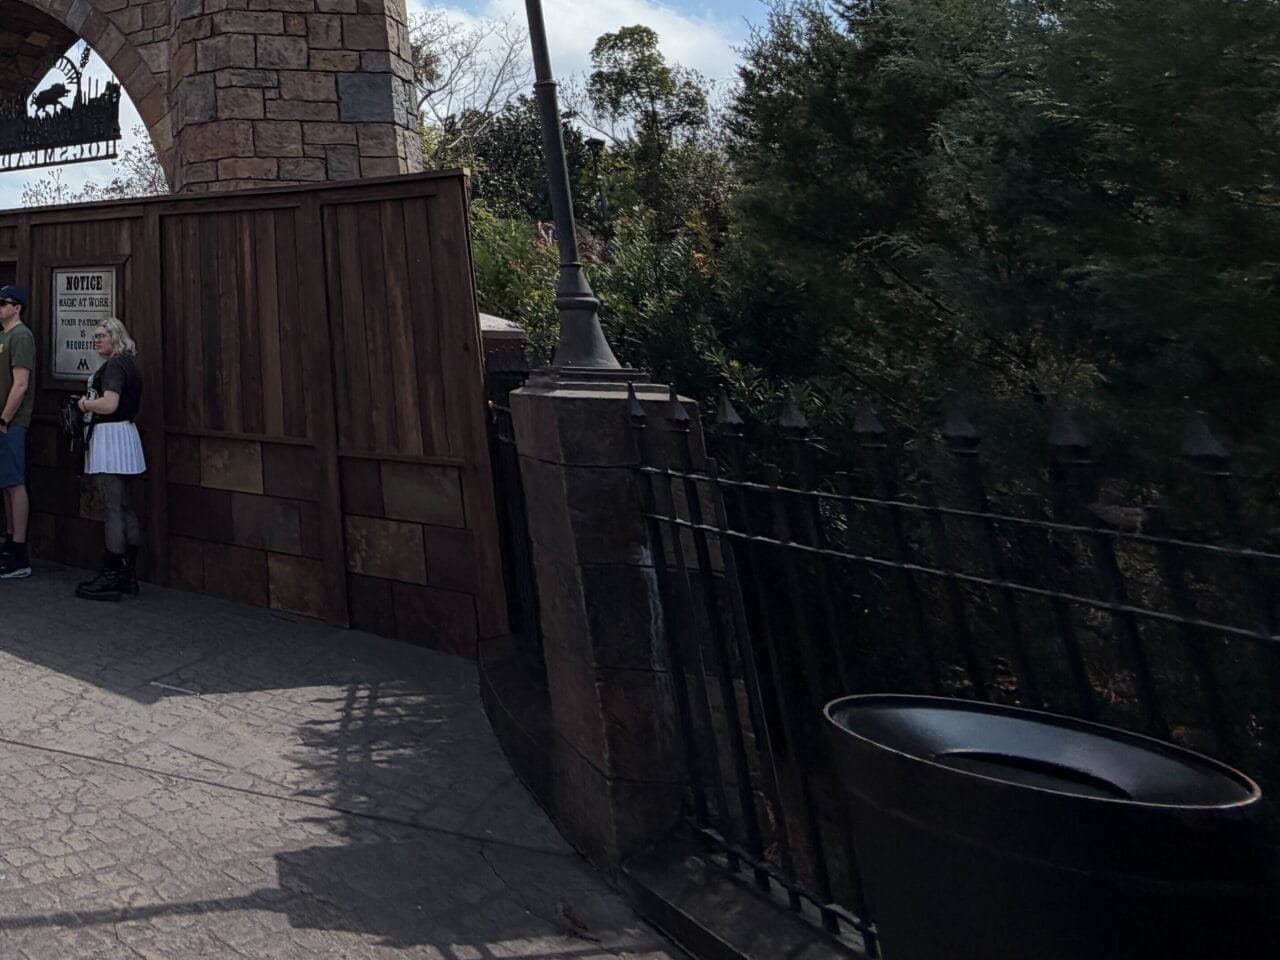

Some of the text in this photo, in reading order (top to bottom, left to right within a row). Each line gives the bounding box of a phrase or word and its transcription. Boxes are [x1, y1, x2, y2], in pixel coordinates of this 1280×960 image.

[66, 276, 103, 291] NOTICE
[59, 297, 109, 308] MAGIC AT WORK
[66, 340, 97, 351] REQUESTE
